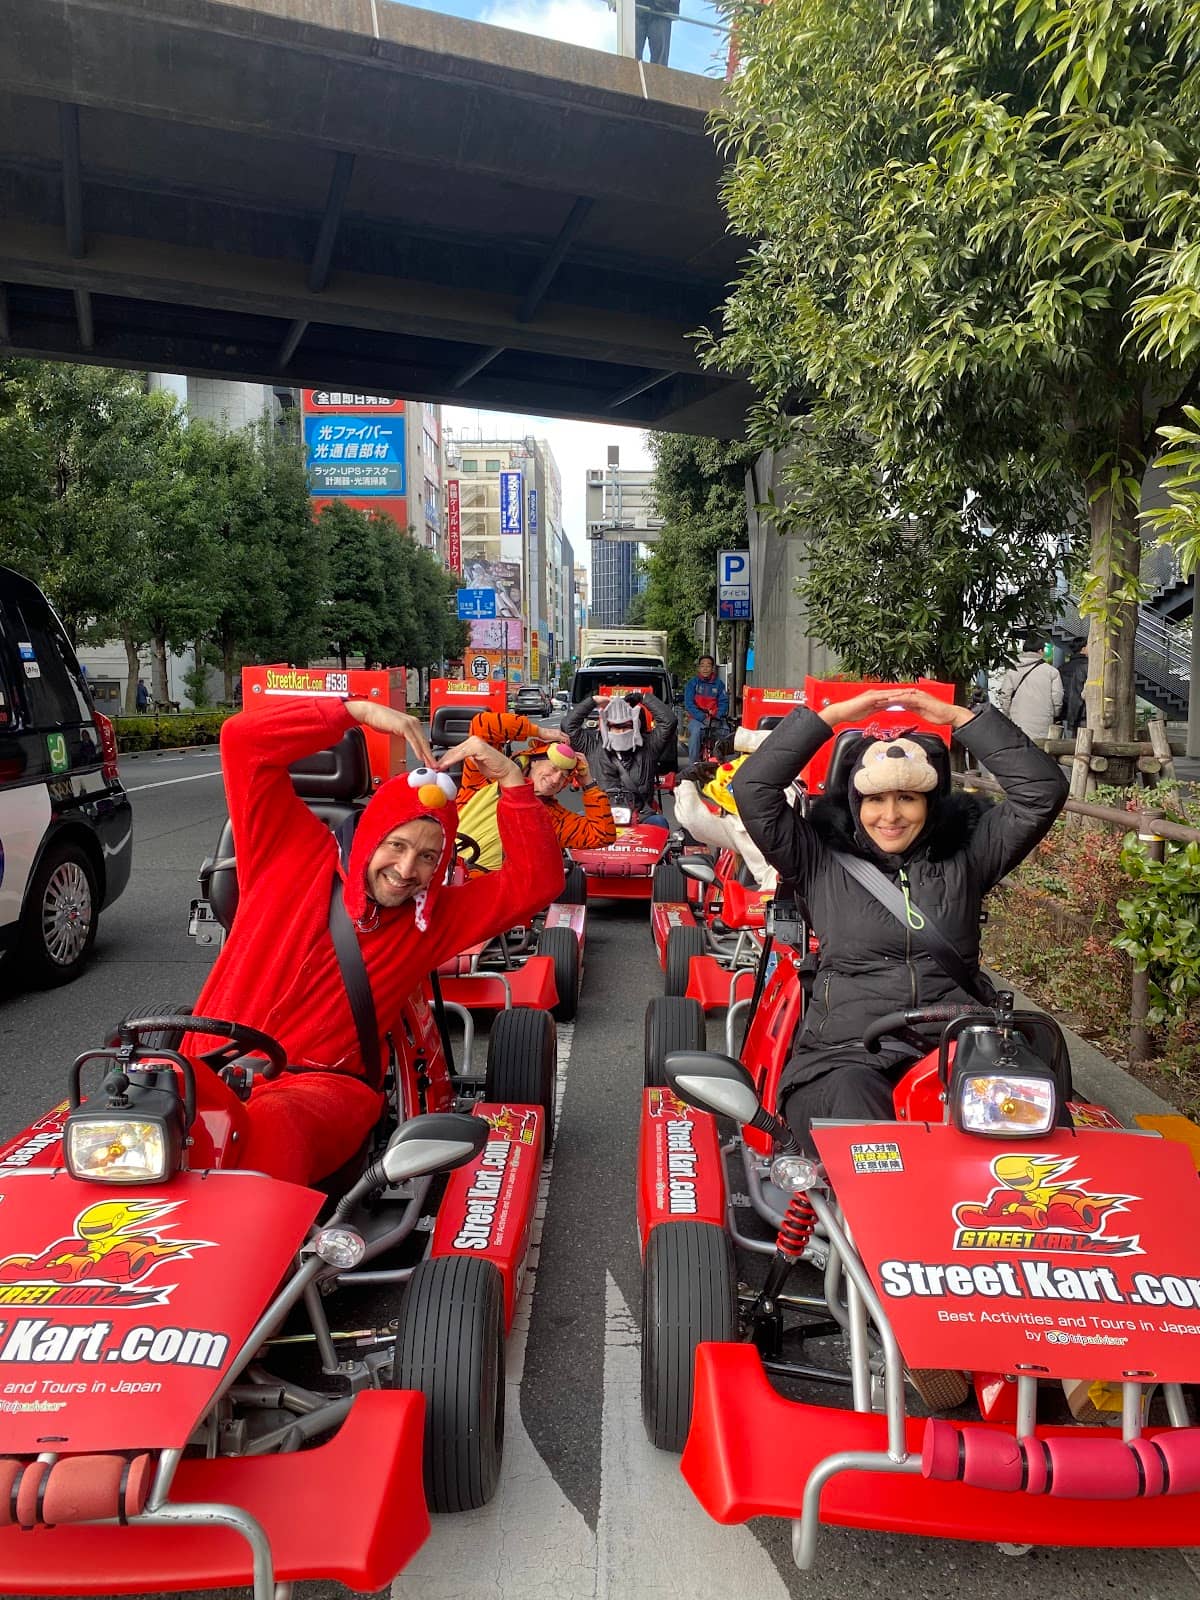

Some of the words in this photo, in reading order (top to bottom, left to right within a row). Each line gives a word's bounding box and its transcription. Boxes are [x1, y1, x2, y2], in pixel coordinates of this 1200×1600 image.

[318, 425, 393, 441] 光ファイバー
[314, 443, 389, 459] 光通信部材
[725, 556, 745, 582] P
[473, 659, 488, 679] 質
[326, 673, 347, 691] #538
[667, 1120, 694, 1152] Street
[453, 1199, 497, 1250] Street
[881, 1261, 1020, 1297] Street
[1022, 1261, 1124, 1302] Kart
[938, 1310, 976, 1322] Best
[980, 1311, 1053, 1326] Activities
[1058, 1315, 1087, 1328] and
[1090, 1317, 1137, 1330] Tours
[1140, 1320, 1154, 1331] in
[2, 1320, 109, 1361] Kart
[1026, 1330, 1041, 1342] by
[4, 1381, 36, 1393] and
[42, 1380, 87, 1393] Tours
[91, 1381, 106, 1392] in
[110, 1380, 162, 1394] Japan
